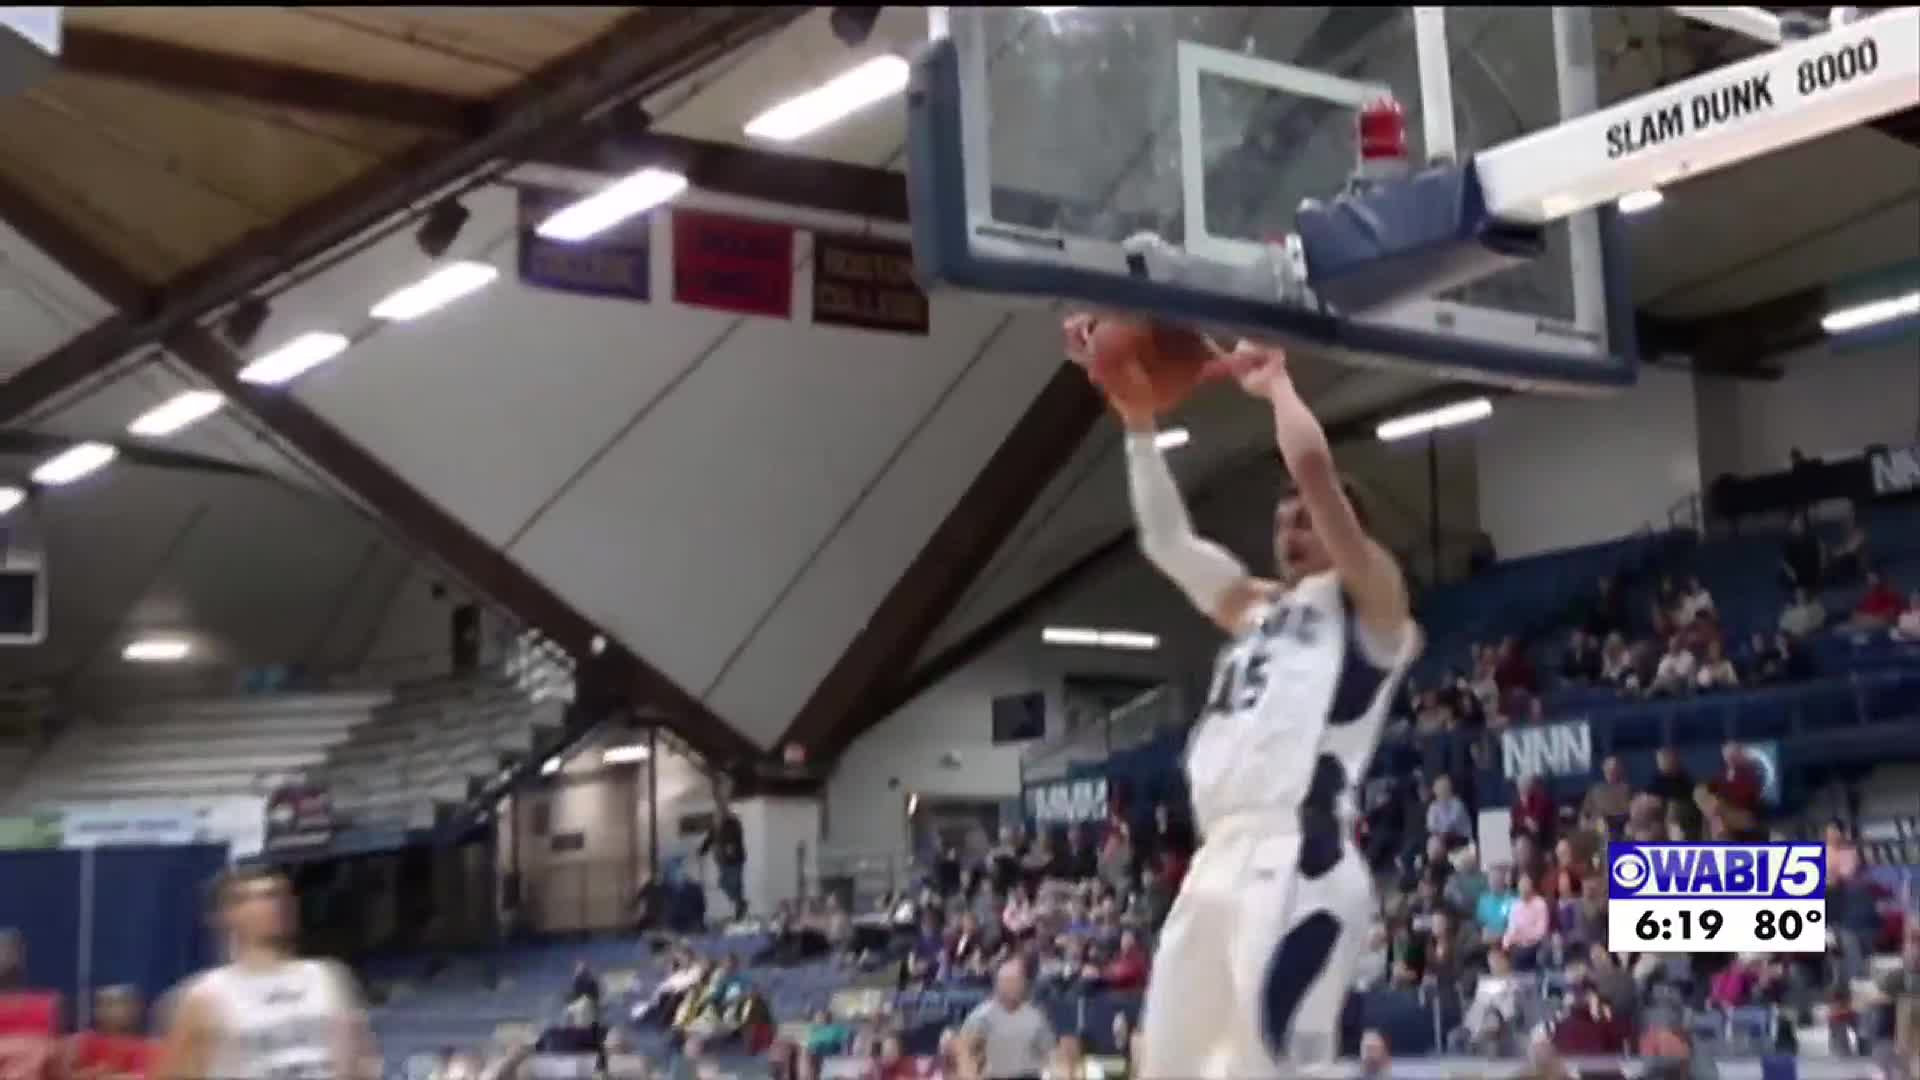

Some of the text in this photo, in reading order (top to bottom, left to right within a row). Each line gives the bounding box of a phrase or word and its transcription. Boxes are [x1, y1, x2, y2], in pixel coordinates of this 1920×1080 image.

[1606, 37, 1878, 159] SLAM DUNK 8000
